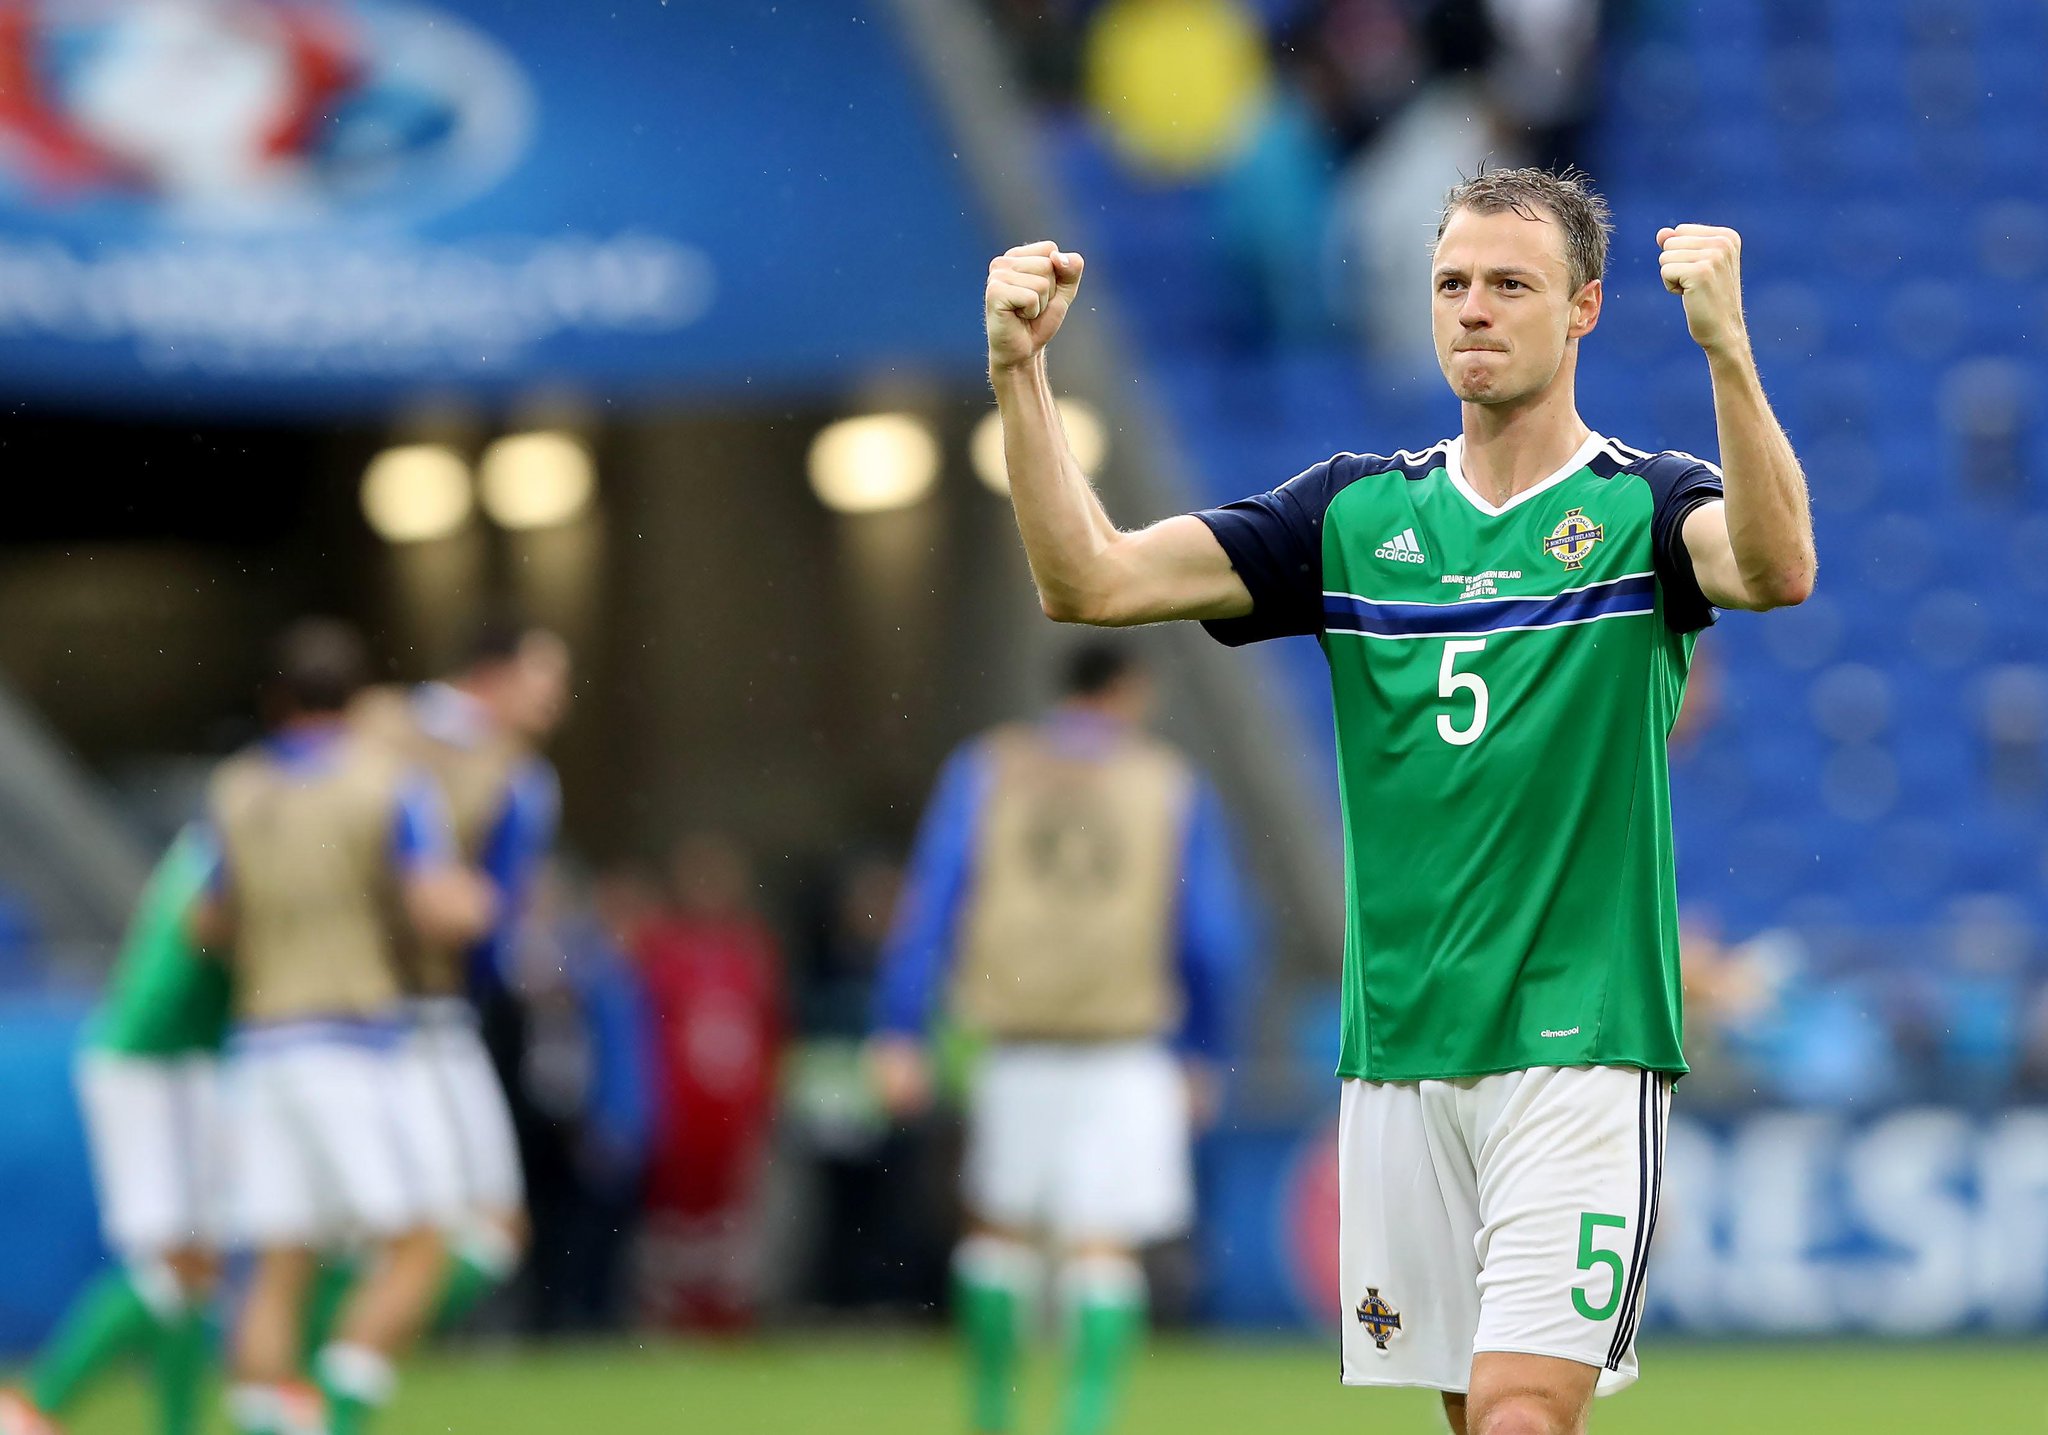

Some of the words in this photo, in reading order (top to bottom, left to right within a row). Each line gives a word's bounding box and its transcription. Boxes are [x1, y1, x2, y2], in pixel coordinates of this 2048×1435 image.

[1567, 517, 1590, 528] FOOTBALL
[1550, 536, 1575, 547] NORTHERN
[1574, 531, 1596, 541] IRELAND
[1375, 547, 1425, 564] adidas
[1556, 546, 1590, 561] ASSOCIATION
[1441, 575, 1464, 583] UKRAINE
[1465, 576, 1472, 584] VS
[1472, 571, 1497, 582] NORTHERN
[1498, 570, 1521, 579] IRELAND
[1482, 579, 1494, 587] 2016
[1482, 587, 1498, 595] LYON
[1435, 638, 1489, 746] 5
[1540, 1026, 1579, 1038] climacool
[1571, 1211, 1626, 1321] 5
